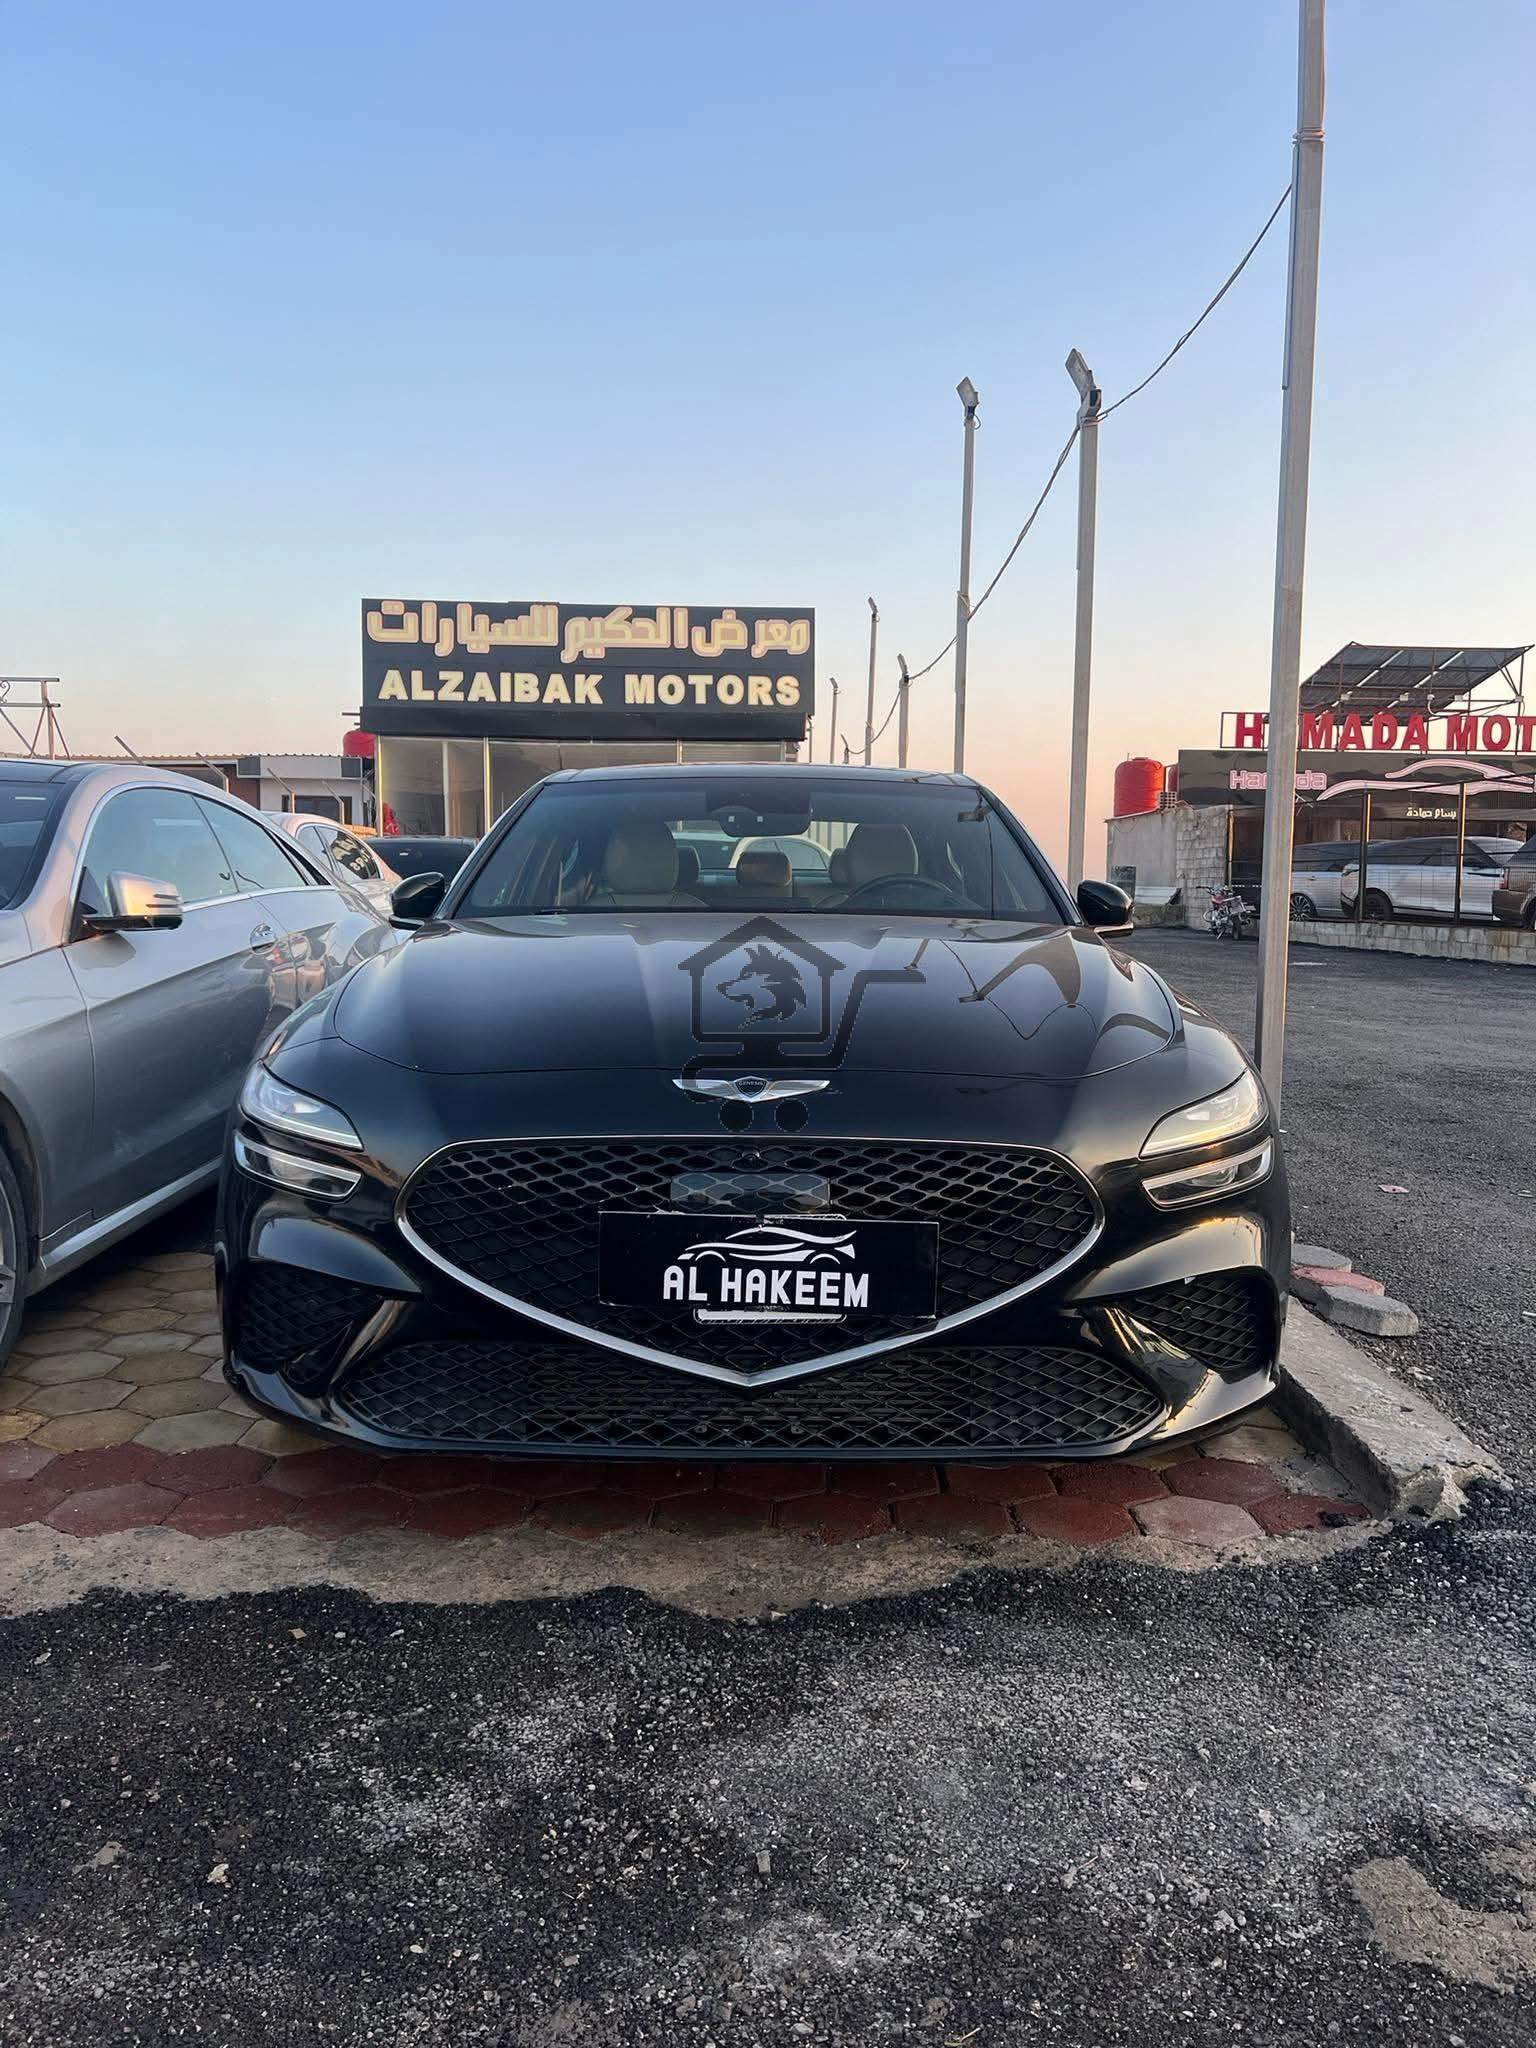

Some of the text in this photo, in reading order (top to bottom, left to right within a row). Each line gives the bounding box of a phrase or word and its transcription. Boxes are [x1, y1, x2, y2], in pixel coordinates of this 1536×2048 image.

[367, 601, 810, 663] معرض الحكيم للسيارات
[378, 670, 801, 706] ALZAIBAK MOTORS
[1235, 711, 1428, 751] HMADA
[1230, 769, 1328, 790] Hada
[663, 1265, 869, 1308] AL HAKEEM
